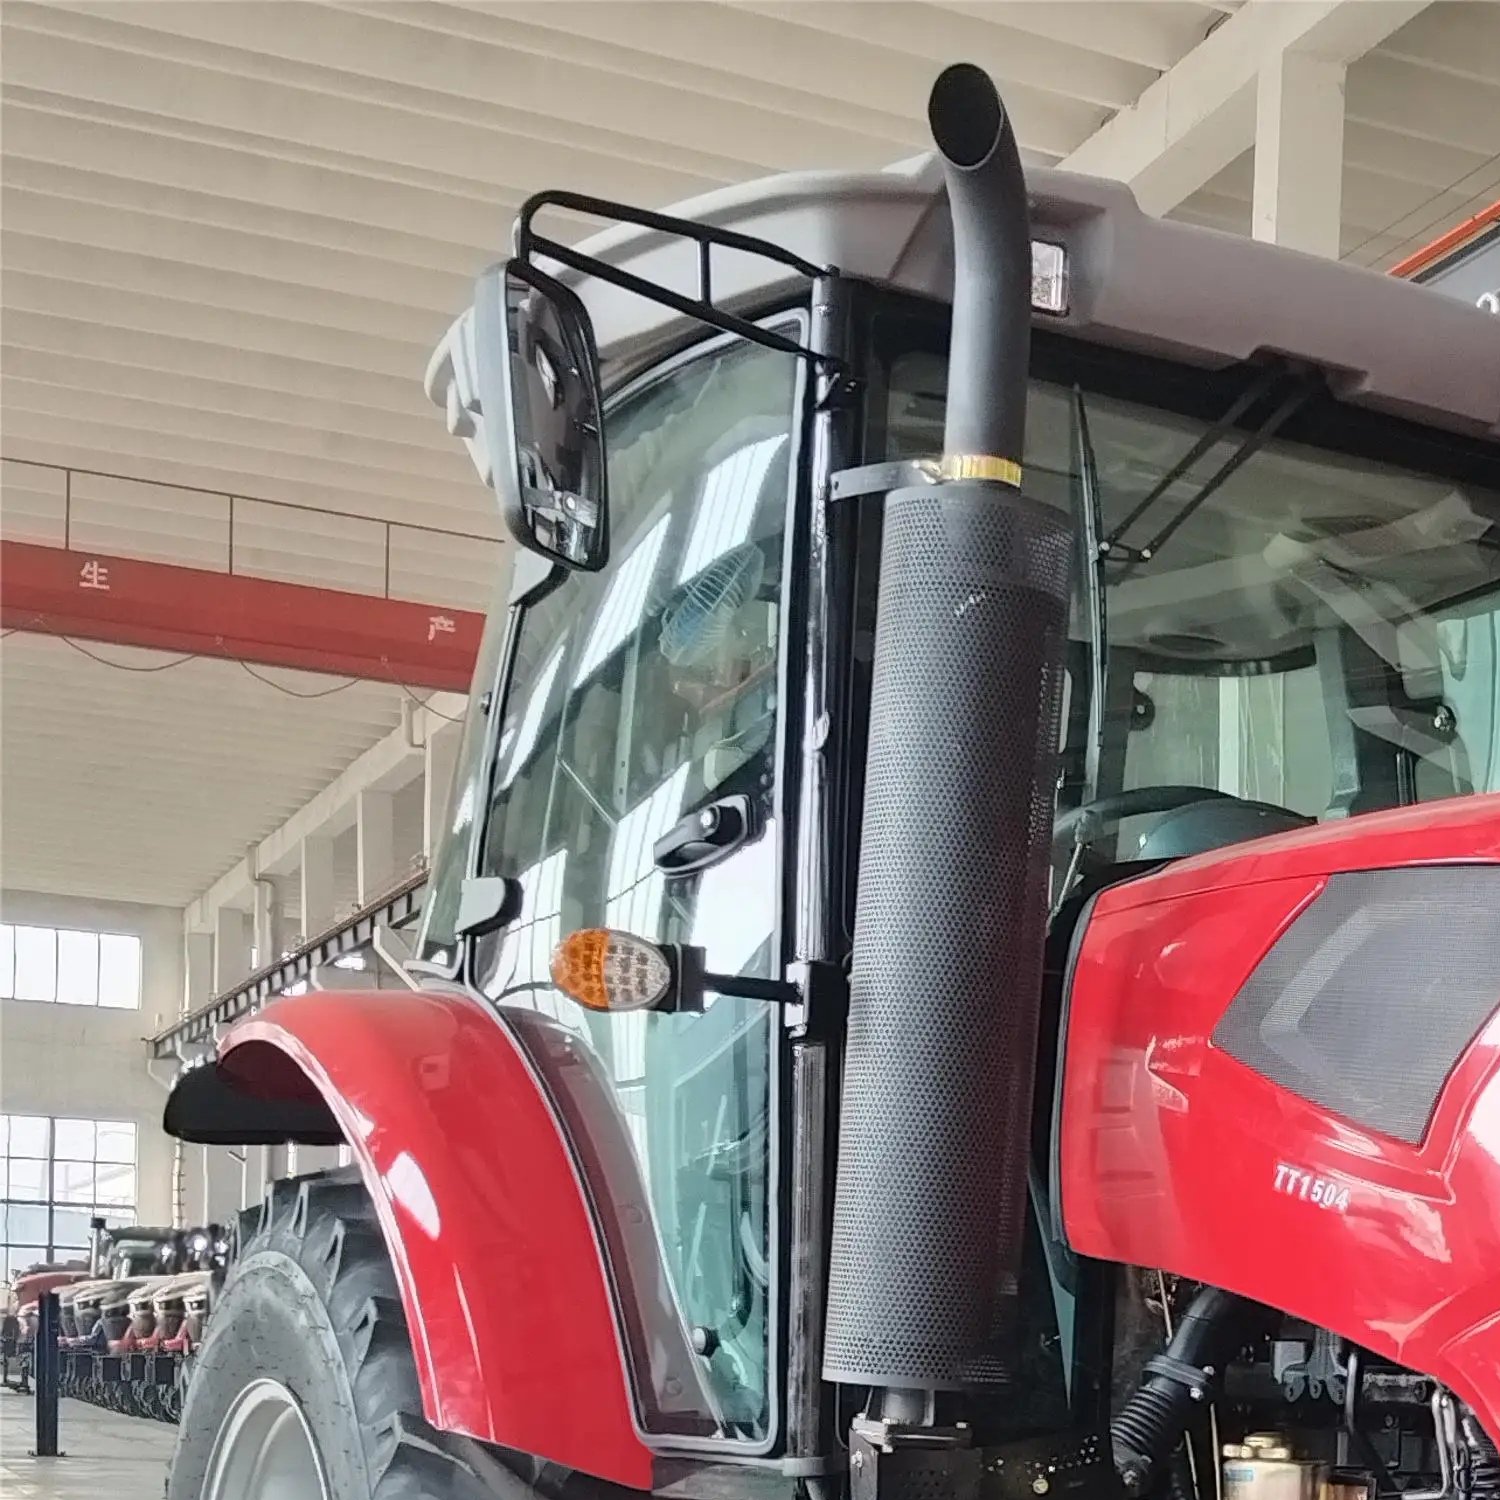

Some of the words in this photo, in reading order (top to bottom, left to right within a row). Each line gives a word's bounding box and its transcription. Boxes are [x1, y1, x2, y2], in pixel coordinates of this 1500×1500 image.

[79, 560, 110, 590] 生
[428, 615, 456, 641] 产
[1273, 1163, 1350, 1213] TT1504
